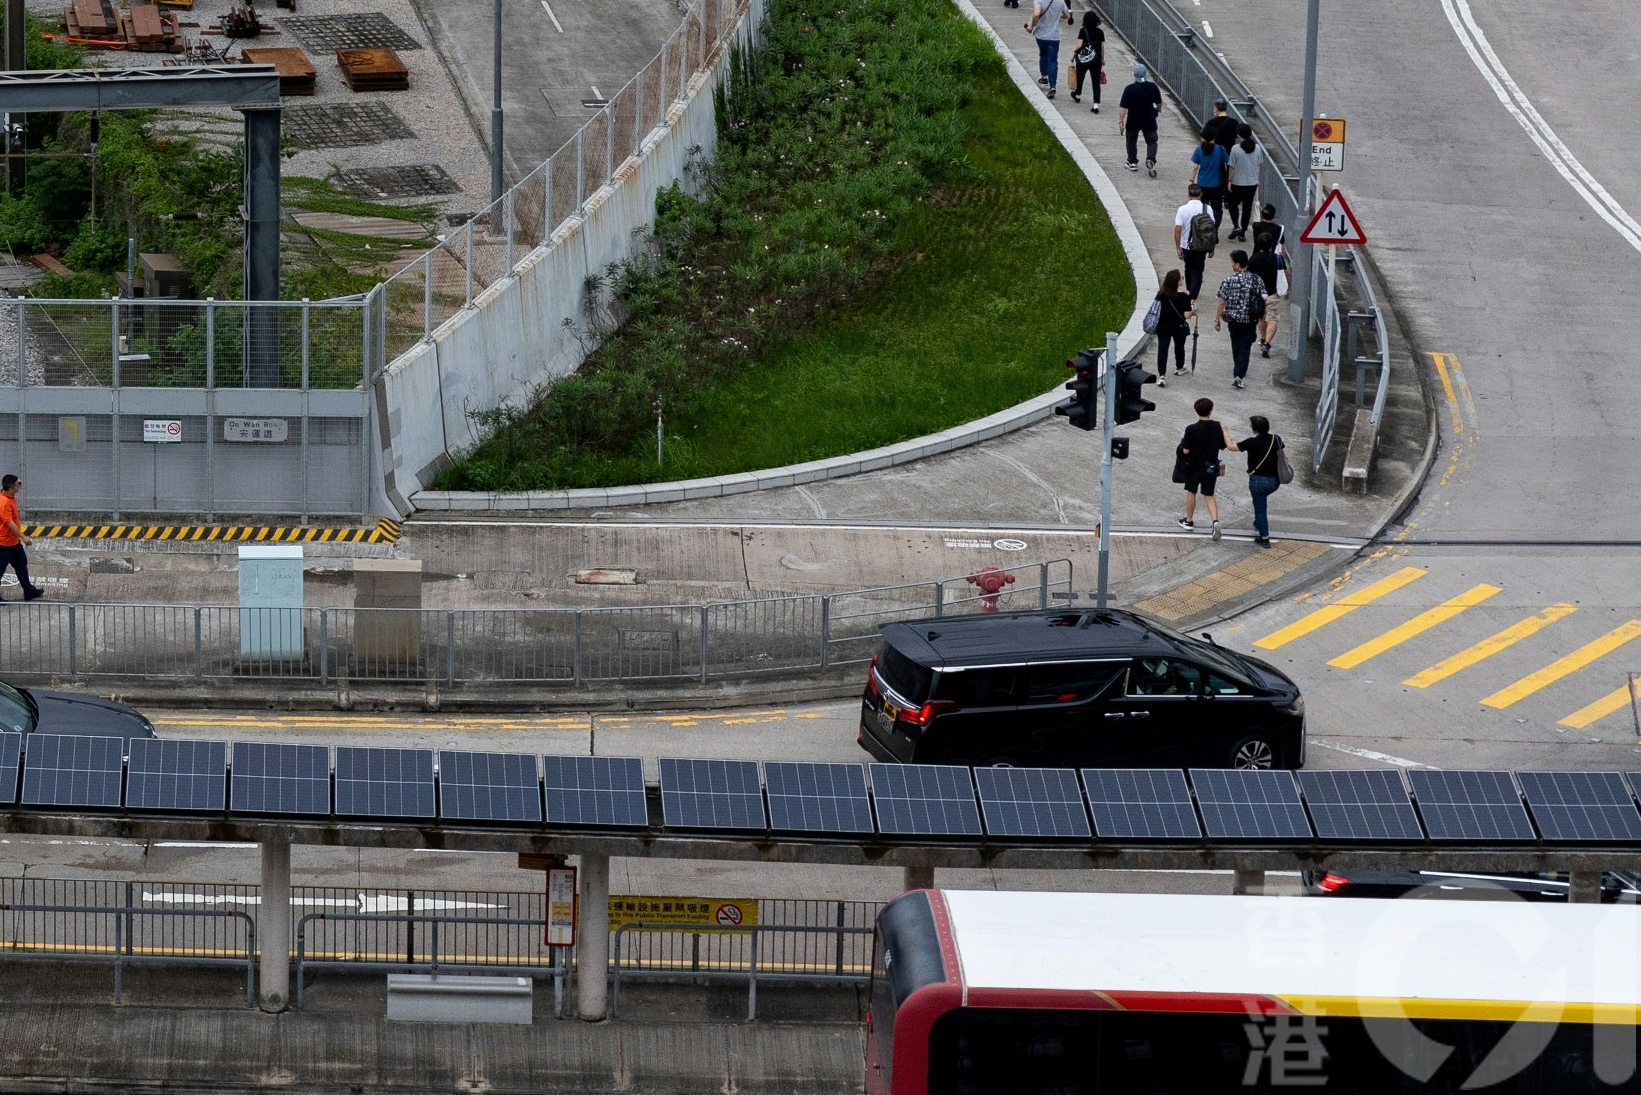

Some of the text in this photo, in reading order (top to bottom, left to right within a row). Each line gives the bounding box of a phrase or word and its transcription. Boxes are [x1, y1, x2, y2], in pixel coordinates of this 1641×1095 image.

[1312, 145, 1332, 155] End
[239, 429, 273, 438] 安運道
